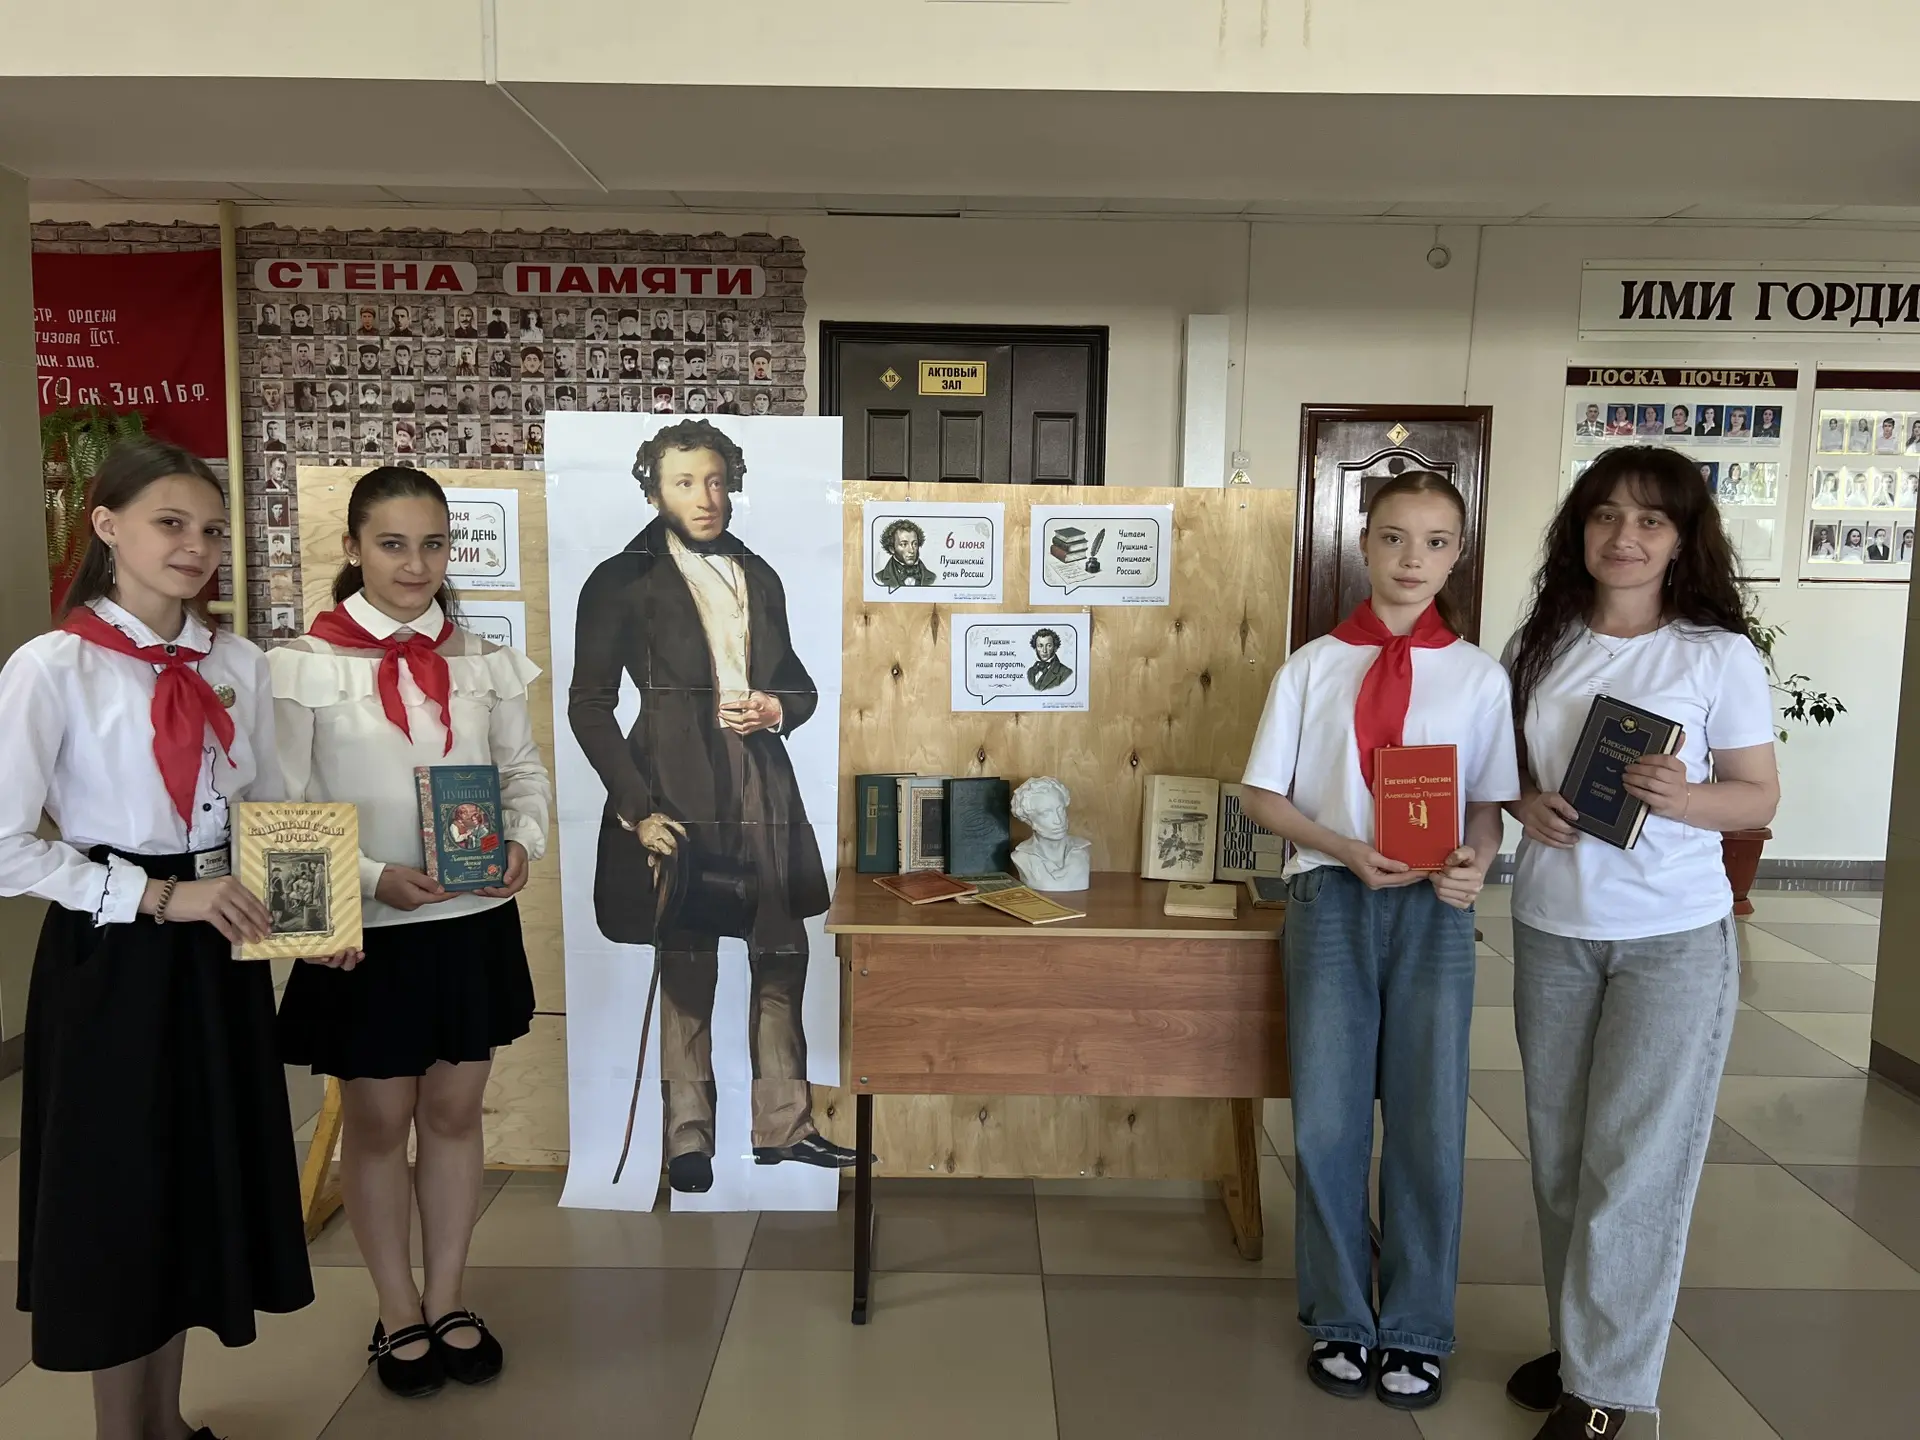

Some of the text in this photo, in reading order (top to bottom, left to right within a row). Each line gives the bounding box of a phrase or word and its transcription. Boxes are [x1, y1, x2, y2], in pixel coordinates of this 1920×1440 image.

[268, 262, 752, 294] СТЕНА ПАМЯТИ
[1619, 280, 1920, 328] ИМИ ГОРДИ
[68, 309, 116, 323] ОРДЕНА
[928, 366, 977, 377] АКТОВЫЙ
[1587, 369, 1776, 387] ДОСКА ПОЧЕТА
[38, 376, 71, 405] 79
[942, 380, 961, 389] ЗАЛ
[471, 530, 497, 542] ДЕНЬ
[1118, 529, 1146, 538] Читаем
[945, 531, 985, 549] 6 июня
[1117, 541, 1148, 553] Пушкина
[450, 546, 480, 562] СИИ
[940, 555, 984, 568] Пушкинский
[942, 568, 984, 581] день России
[1116, 566, 1142, 575] Россию.
[983, 636, 1010, 648] Пушкин
[994, 662, 1026, 670] гордость,
[994, 673, 1025, 681] наследие.
[1600, 735, 1641, 758] Александр
[1384, 775, 1452, 786] Евгений Онегин
[1422, 790, 1451, 798] Пушкин
[1225, 795, 1244, 814] ПО
[274, 833, 319, 843] ДОЧКА
[1223, 849, 1256, 869] ПОРЫ
